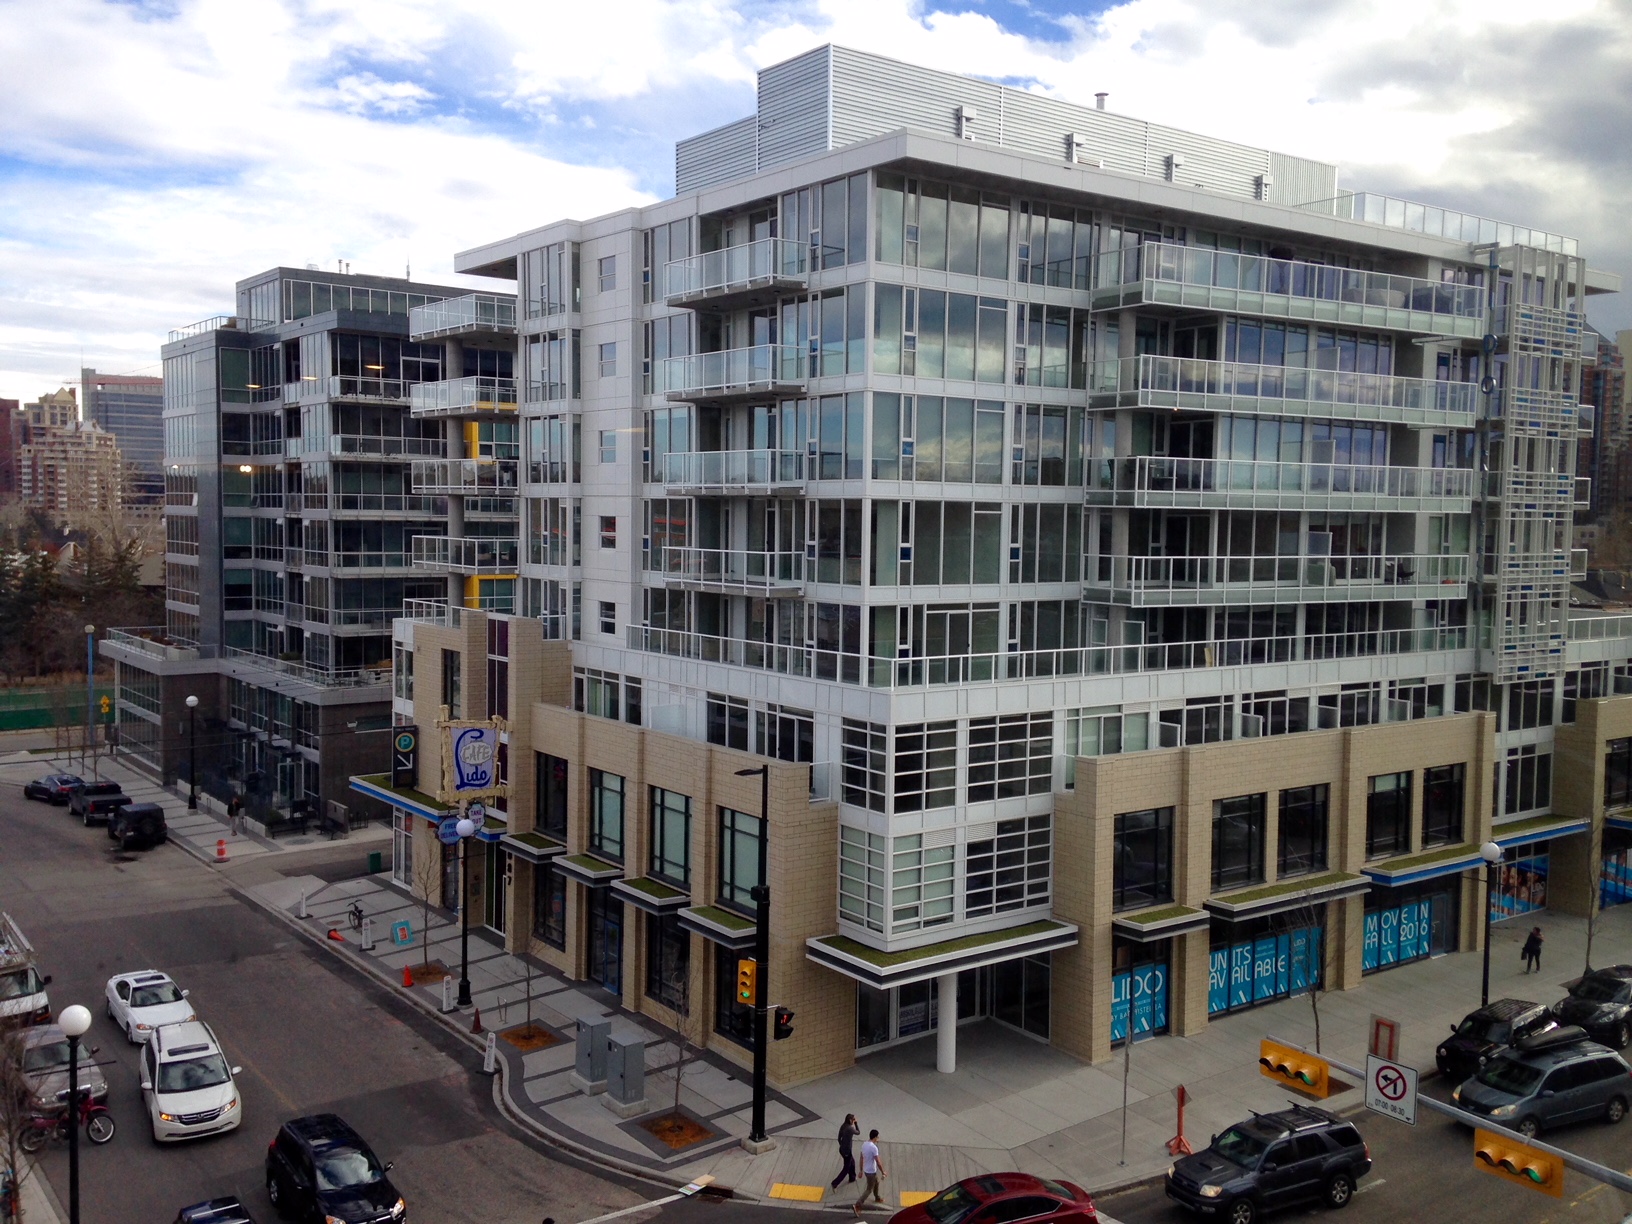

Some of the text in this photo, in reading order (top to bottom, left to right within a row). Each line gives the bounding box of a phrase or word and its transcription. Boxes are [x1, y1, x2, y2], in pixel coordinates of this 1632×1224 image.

[400, 736, 410, 749] P
[462, 745, 491, 761] CAFE
[455, 728, 491, 791] Lido
[471, 809, 482, 817] TAKE
[1366, 902, 1429, 934] MOVE IN
[1364, 919, 1429, 951] FALL 2016
[1208, 954, 1286, 992] AVAILABLE
[1209, 945, 1252, 973] UNITS
[1111, 970, 1164, 1004] LIDO
[1375, 1099, 1388, 1110] 07:00
